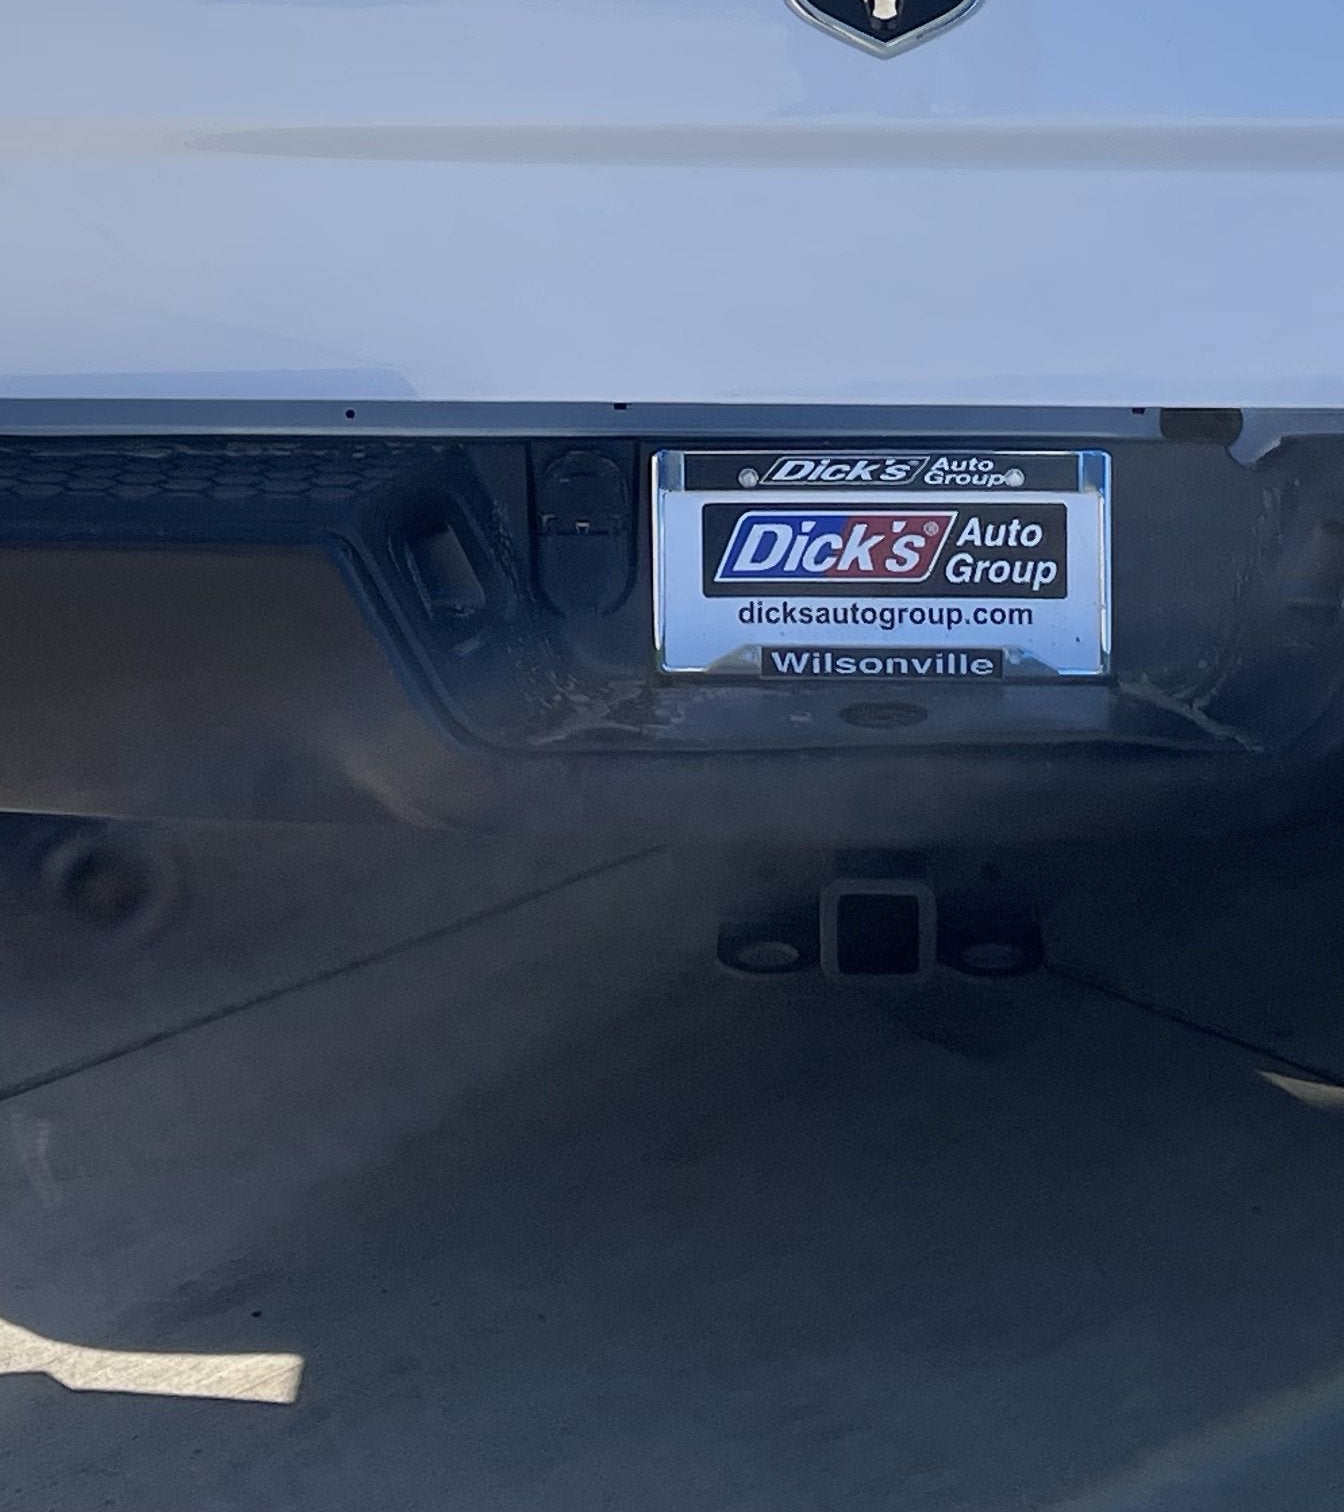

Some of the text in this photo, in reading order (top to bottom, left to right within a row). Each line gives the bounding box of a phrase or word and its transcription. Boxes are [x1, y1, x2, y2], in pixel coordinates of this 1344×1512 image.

[771, 456, 996, 482] Dick's Auto
[923, 470, 1007, 488] Group
[731, 517, 1044, 574] Dick's Auto
[945, 552, 1058, 592] Group
[737, 601, 1034, 631] dicksautogroup.com
[771, 650, 995, 676] Wilsonville
